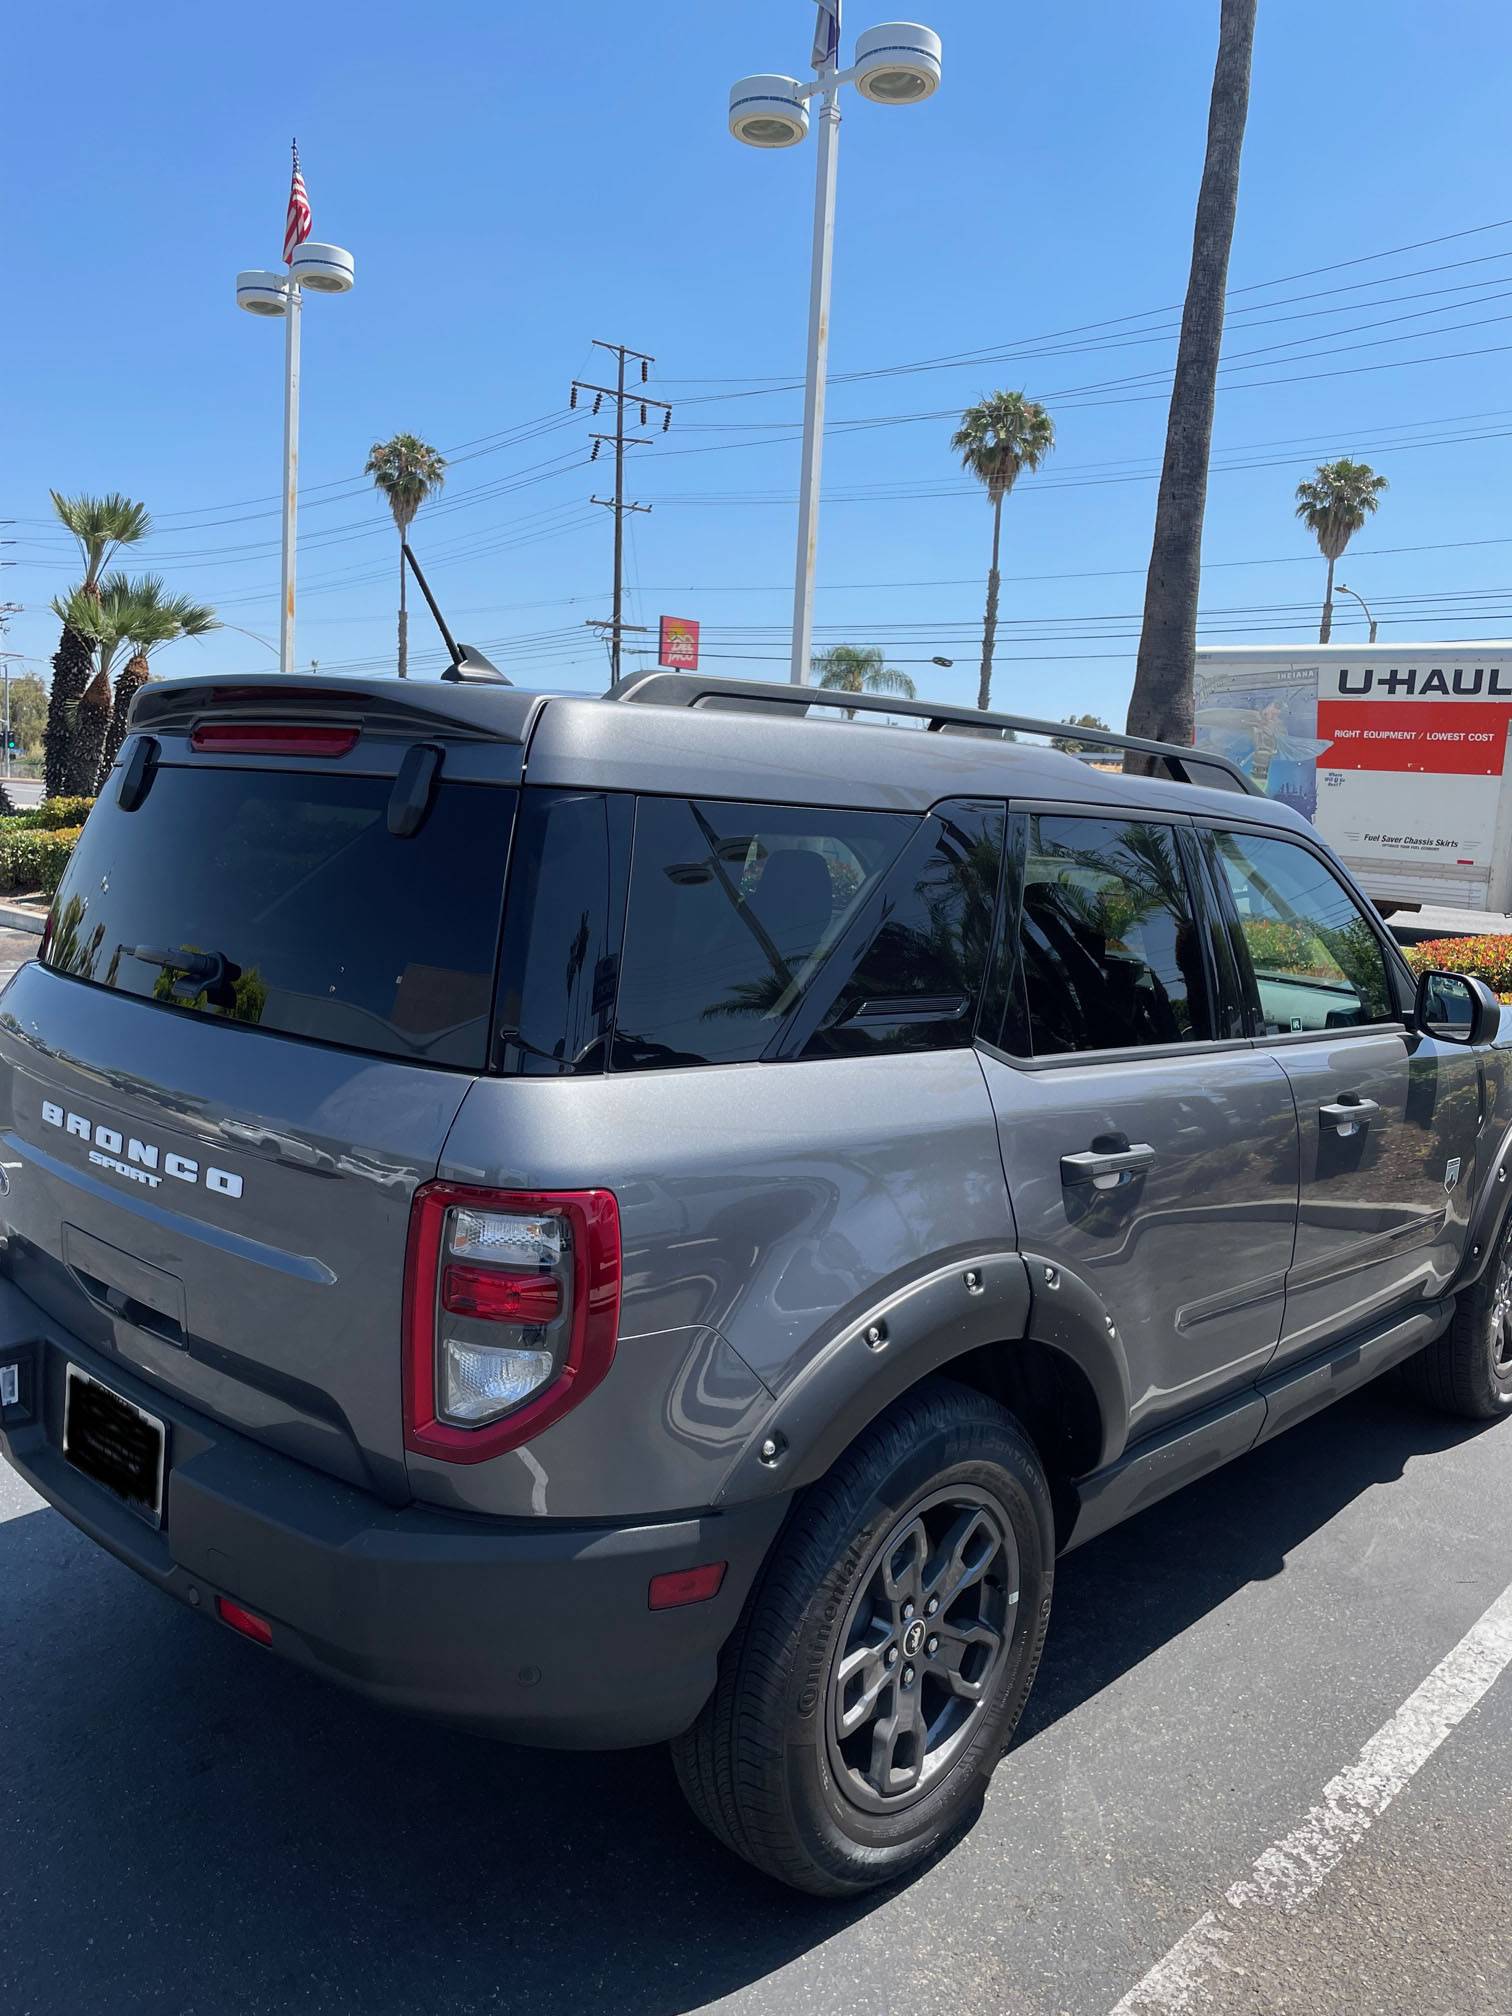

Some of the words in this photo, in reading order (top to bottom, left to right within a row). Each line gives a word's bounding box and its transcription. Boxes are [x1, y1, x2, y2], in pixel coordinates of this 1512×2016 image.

[1338, 669, 1512, 695] U-HAUL
[1334, 730, 1361, 738] RIGHT
[1363, 730, 1417, 740] EQUIPMENT
[1426, 732, 1466, 741] LOWEST
[1468, 733, 1495, 742] COST
[1363, 833, 1380, 842] Fuel
[1381, 834, 1402, 844] Saver
[1403, 836, 1434, 846] Chassis
[1435, 839, 1459, 848] Skirts
[42, 1100, 243, 1199] BRONCO
[88, 1150, 163, 1188] SPORT
